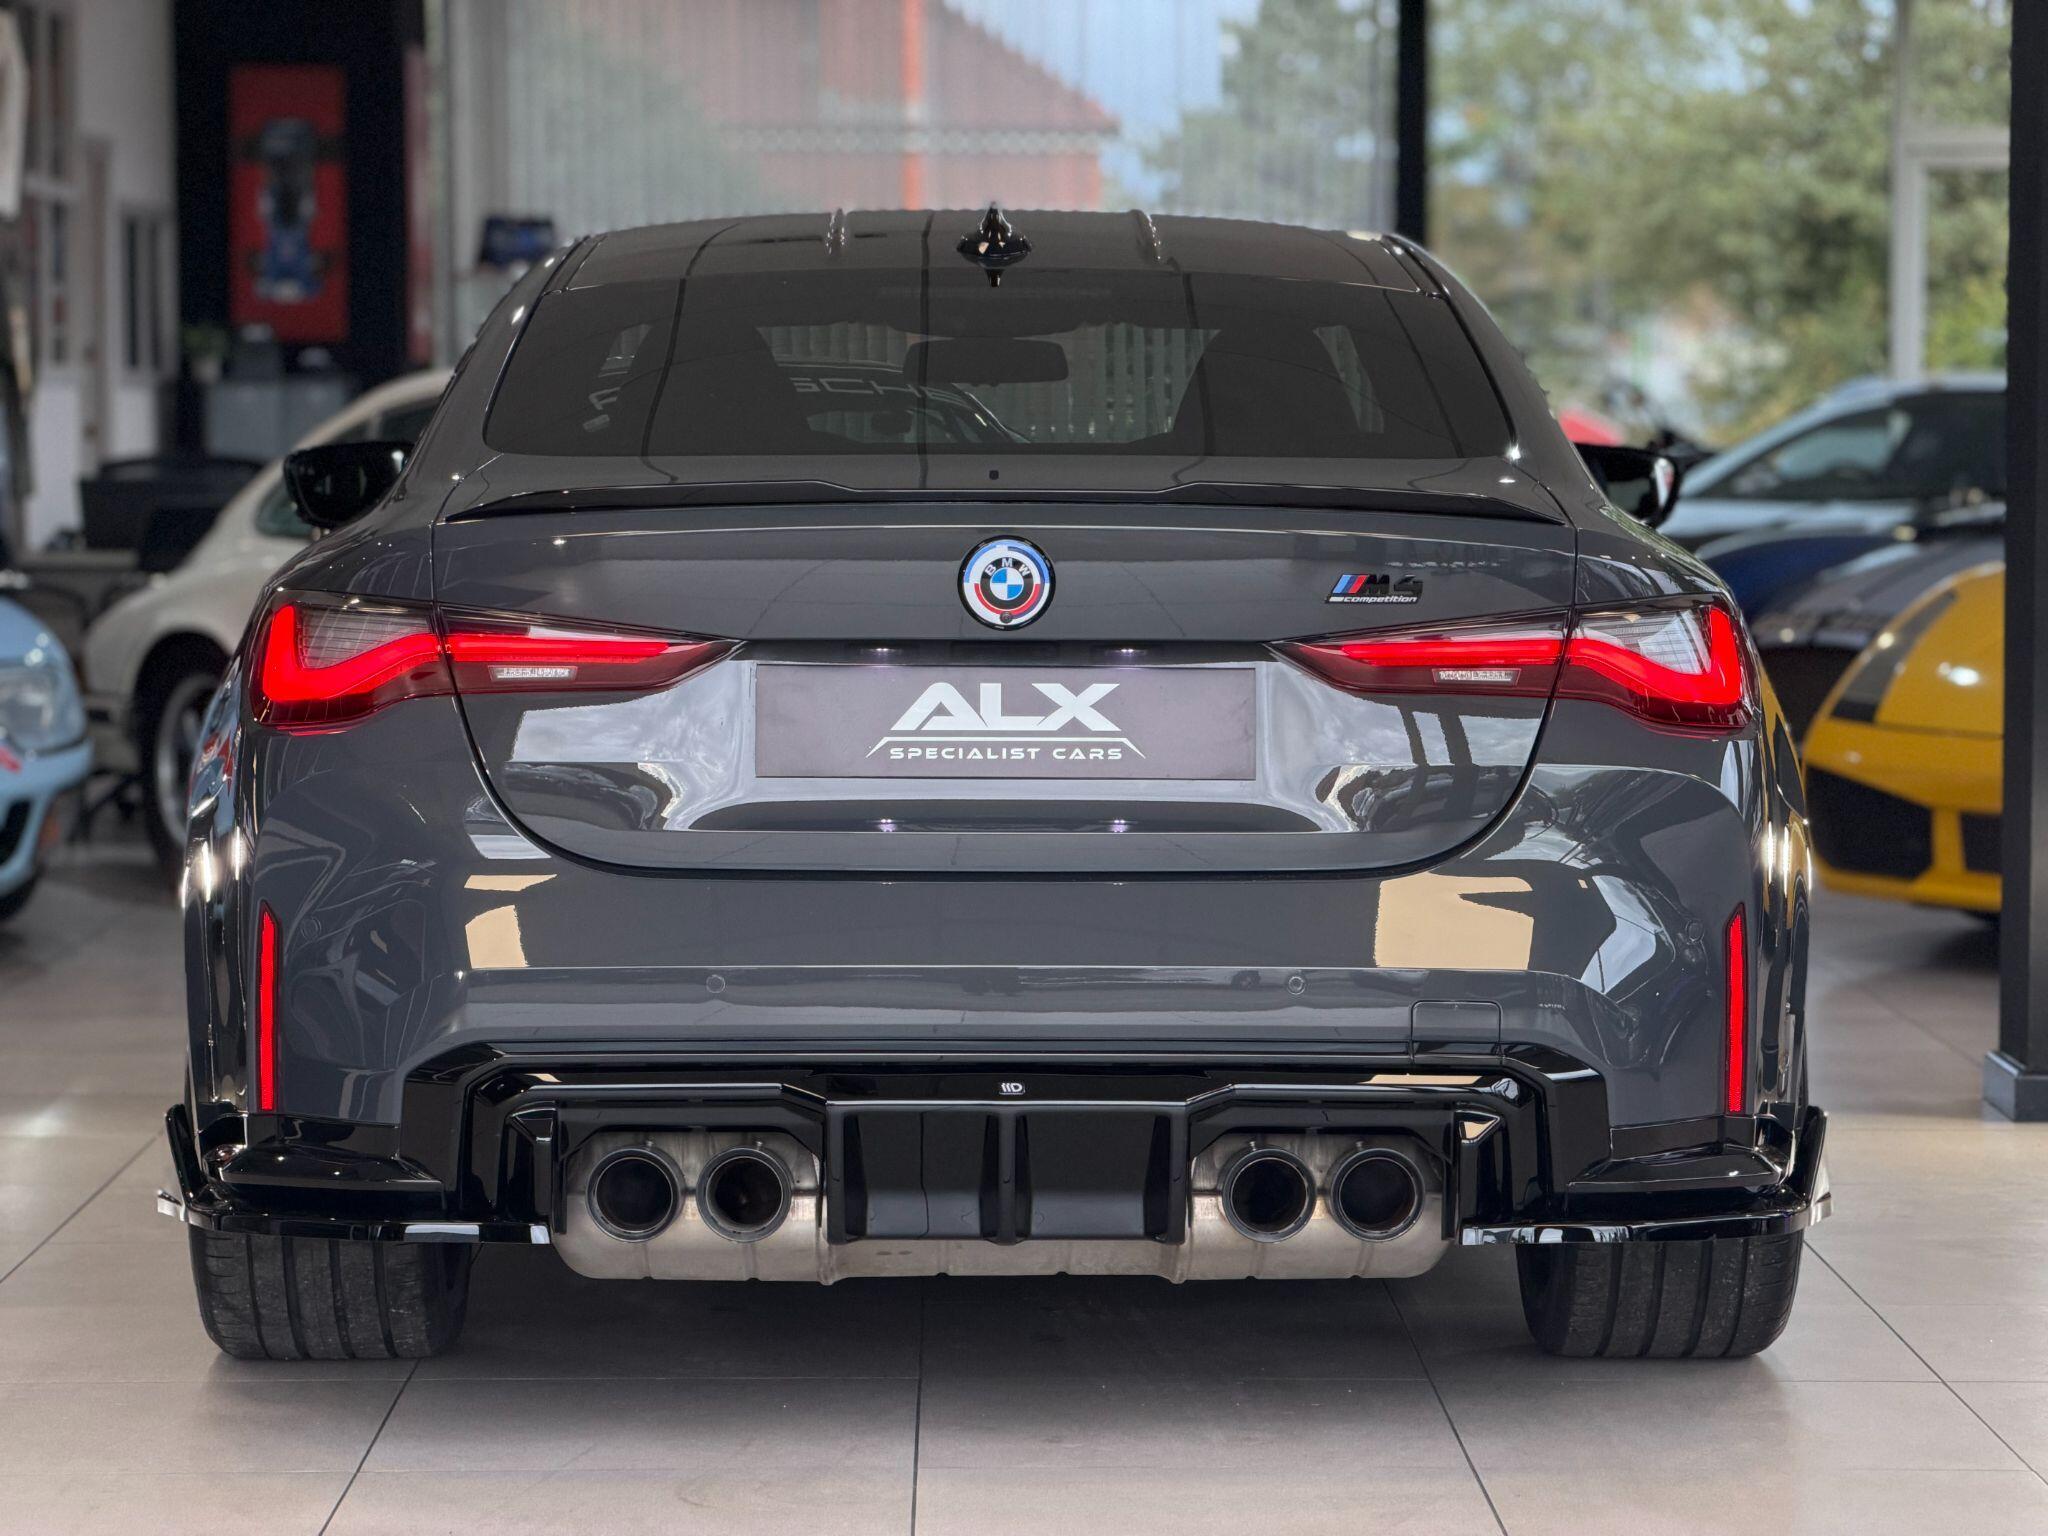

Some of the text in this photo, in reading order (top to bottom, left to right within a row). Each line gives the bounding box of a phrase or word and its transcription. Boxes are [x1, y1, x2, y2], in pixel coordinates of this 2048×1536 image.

[984, 557, 1030, 577] BMW
[1343, 595, 1418, 604] competition
[890, 682, 1121, 731] ALX
[890, 747, 1123, 760] SPECIALIST CARS
